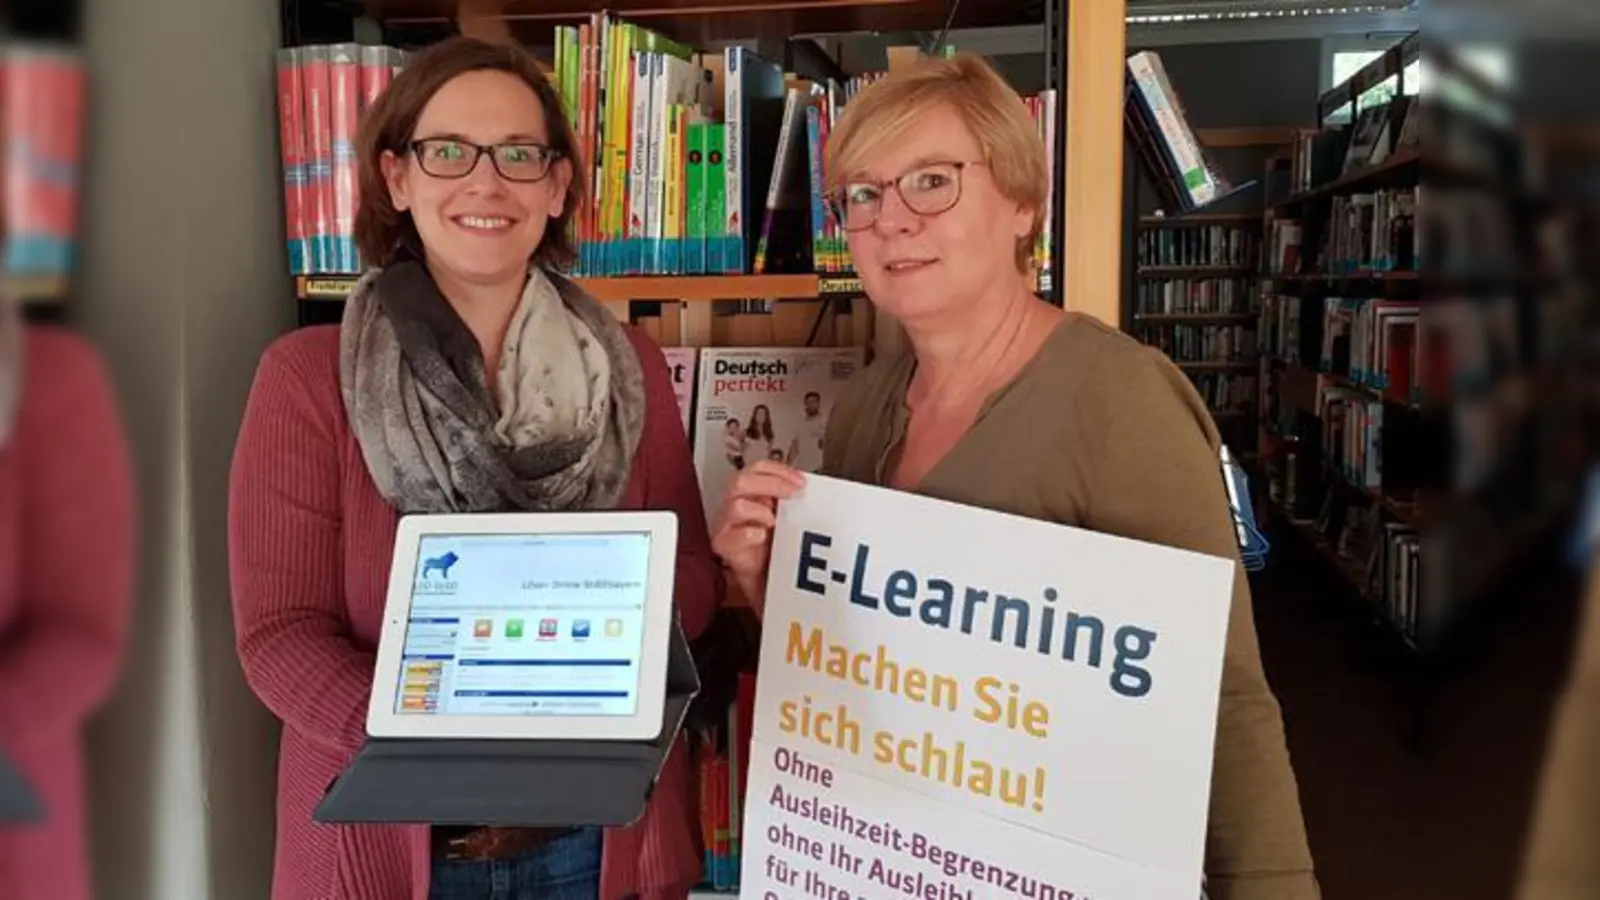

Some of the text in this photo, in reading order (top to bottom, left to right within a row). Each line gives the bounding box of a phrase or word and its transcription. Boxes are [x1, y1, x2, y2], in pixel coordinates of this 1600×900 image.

[821, 279, 865, 292] Deutsc
[713, 375, 788, 396] perfekt
[714, 358, 788, 376] Deutsch
[796, 530, 1158, 698] E-Learning
[785, 620, 1050, 737] Machen Sie
[774, 747, 834, 789] Ohne
[778, 696, 1048, 812] sich schlau!
[767, 824, 823, 863] ohne
[831, 843, 863, 875] Ihr
[765, 855, 850, 900] für Ihre
